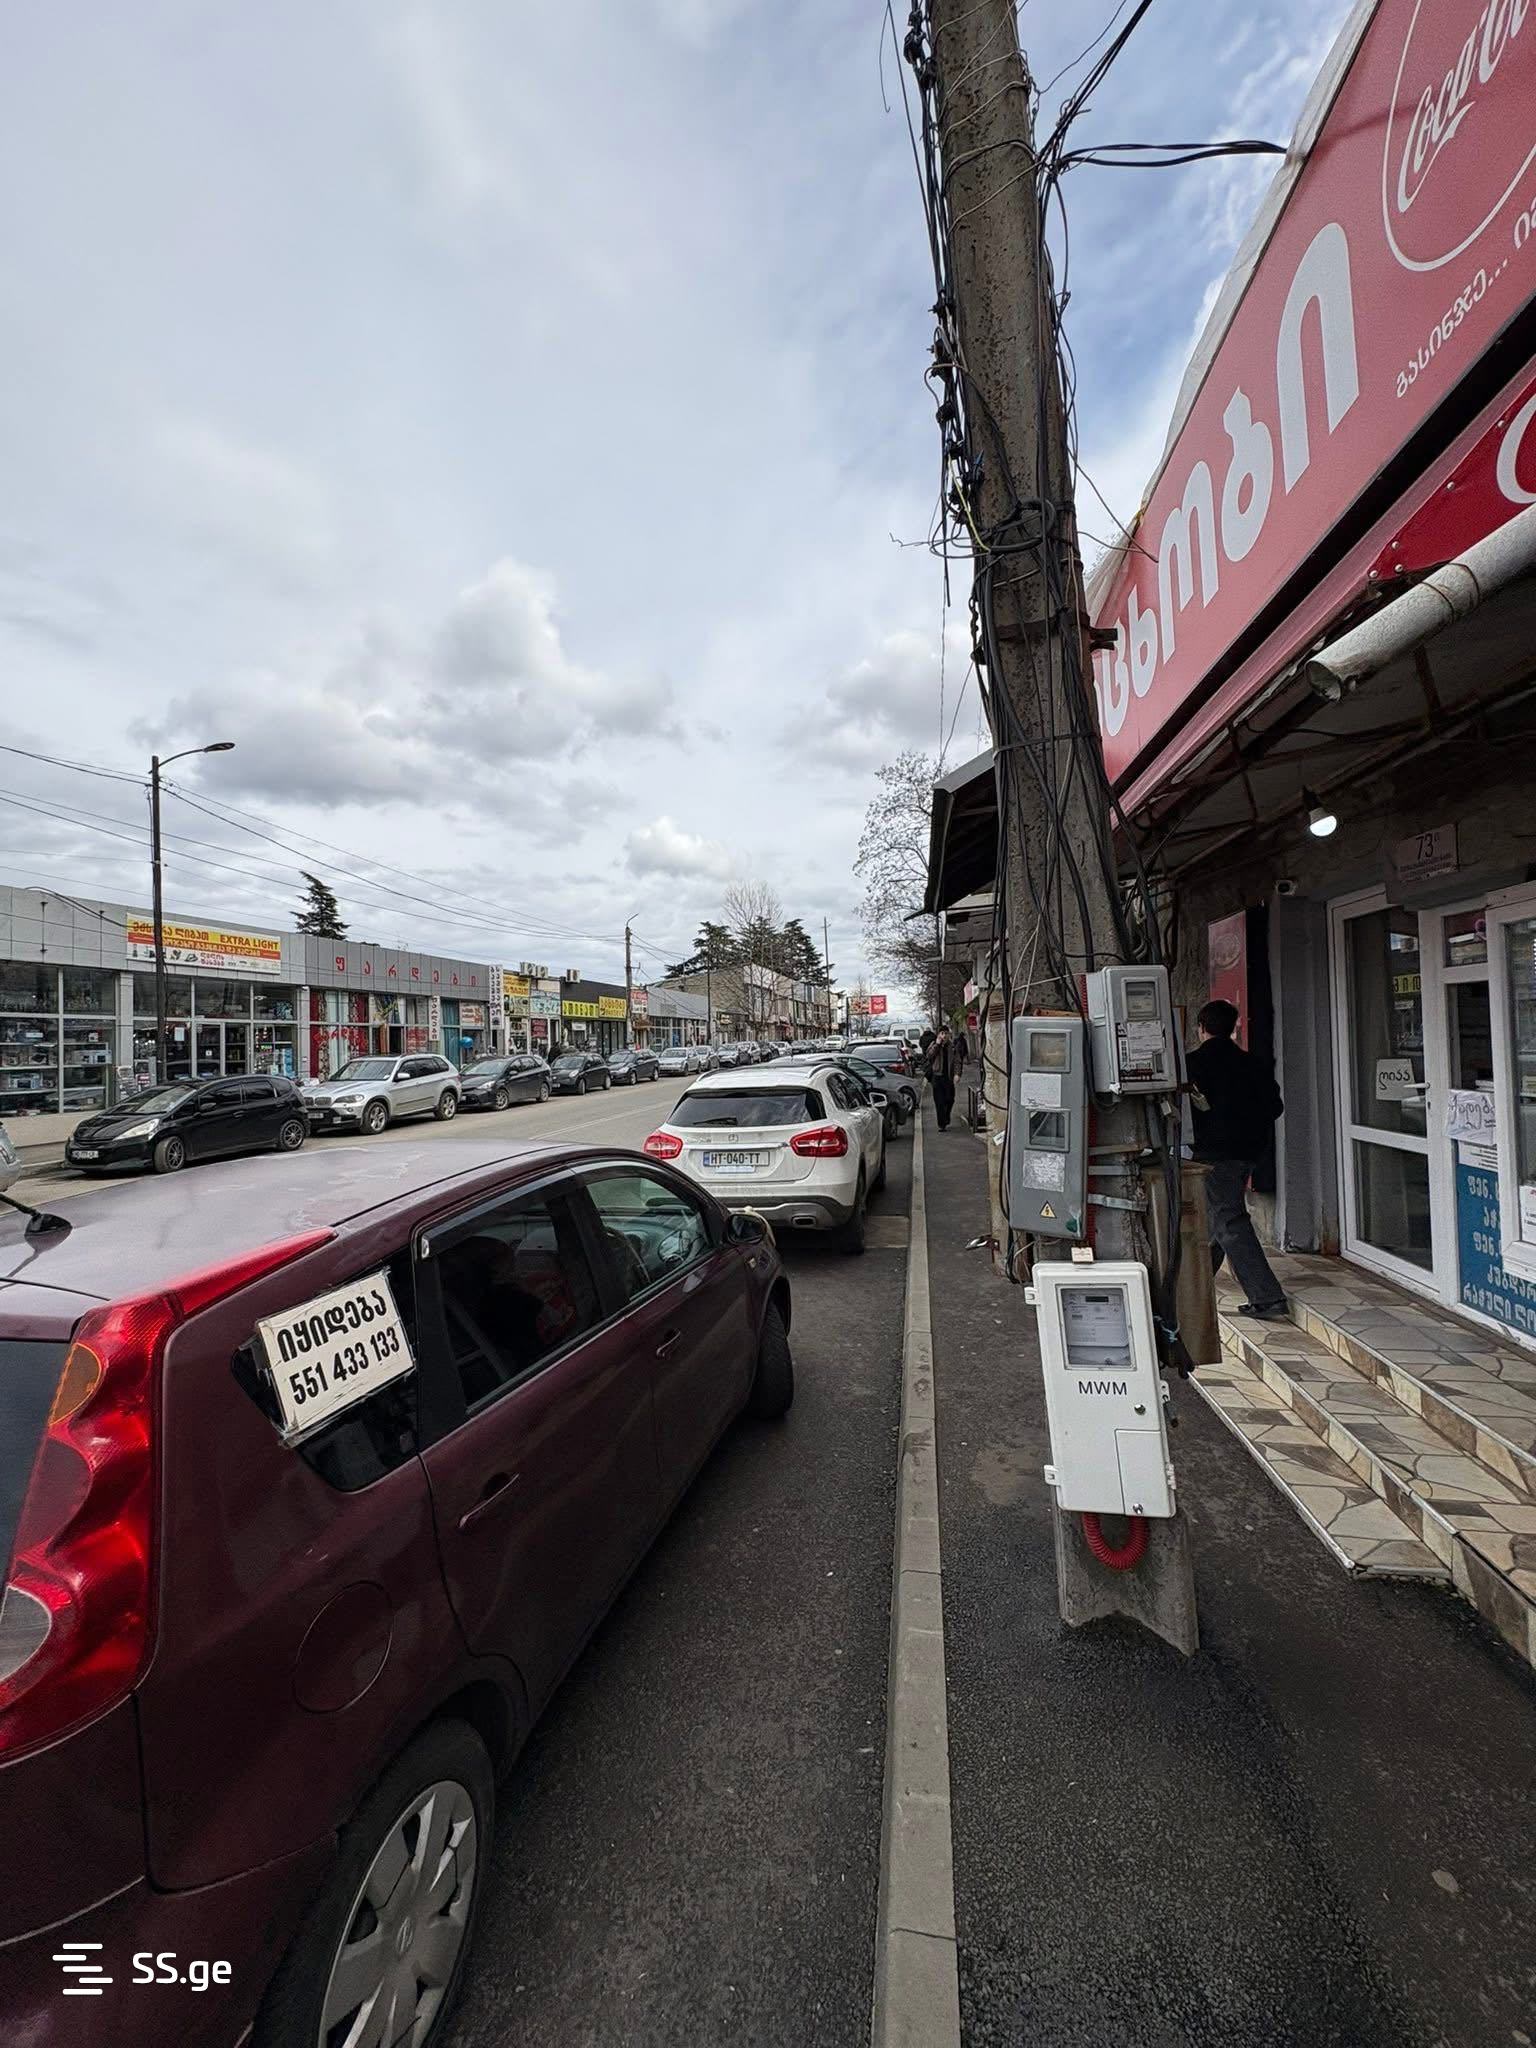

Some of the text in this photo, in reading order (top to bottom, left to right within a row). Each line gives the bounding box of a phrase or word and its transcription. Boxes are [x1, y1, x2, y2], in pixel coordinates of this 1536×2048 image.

[1094, 222, 1360, 737] ცხობი
[220, 934, 279, 951] EXTRA LIGHT
[335, 956, 478, 988] ფარდები
[710, 1152, 761, 1165] HT-040-TT
[276, 1289, 387, 1363] იყიდება
[289, 1326, 400, 1405] 551 433 133
[1077, 1380, 1128, 1396] MWM
